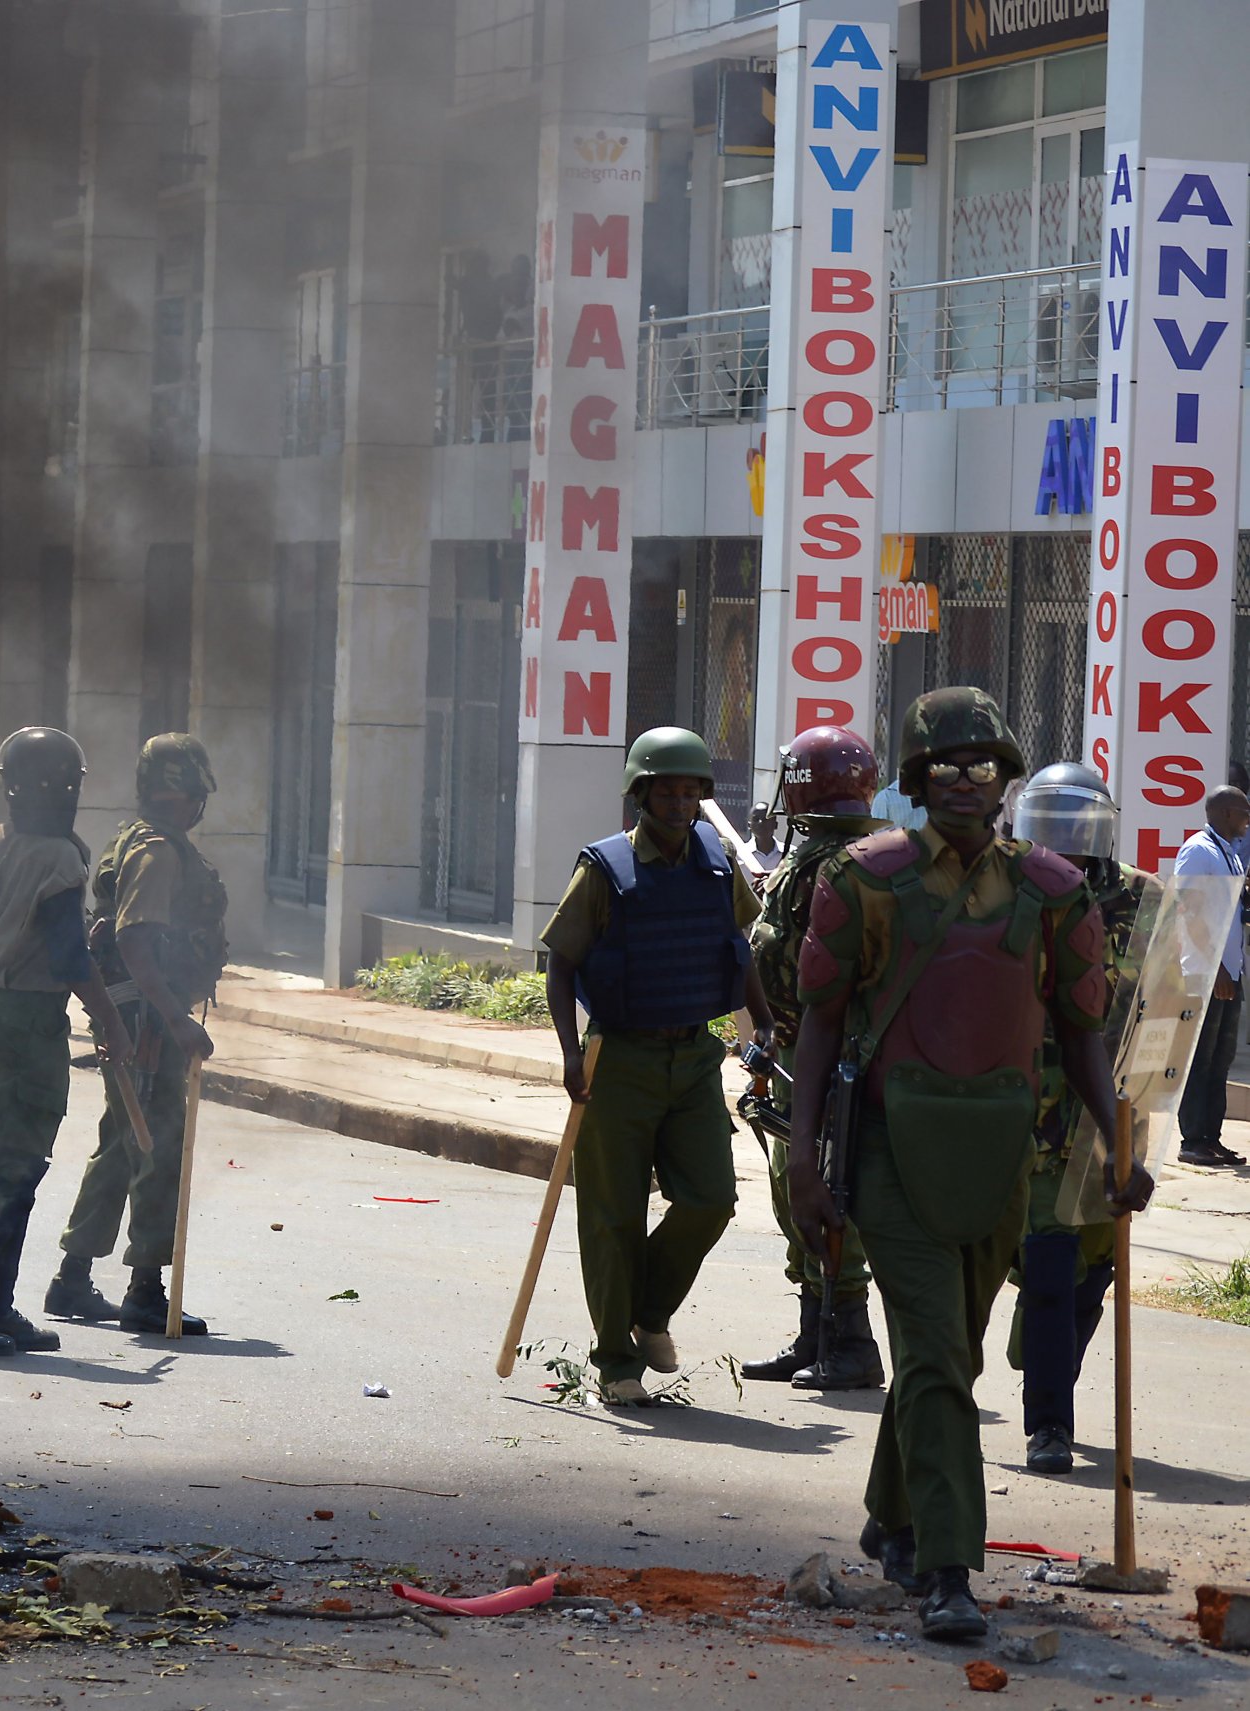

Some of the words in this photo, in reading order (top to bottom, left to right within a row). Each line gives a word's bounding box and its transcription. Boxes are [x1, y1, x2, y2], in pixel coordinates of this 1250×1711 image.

[565, 166, 642, 184] magman
[557, 212, 630, 737] MAGMAN
[784, 768, 812, 785] POLICE
